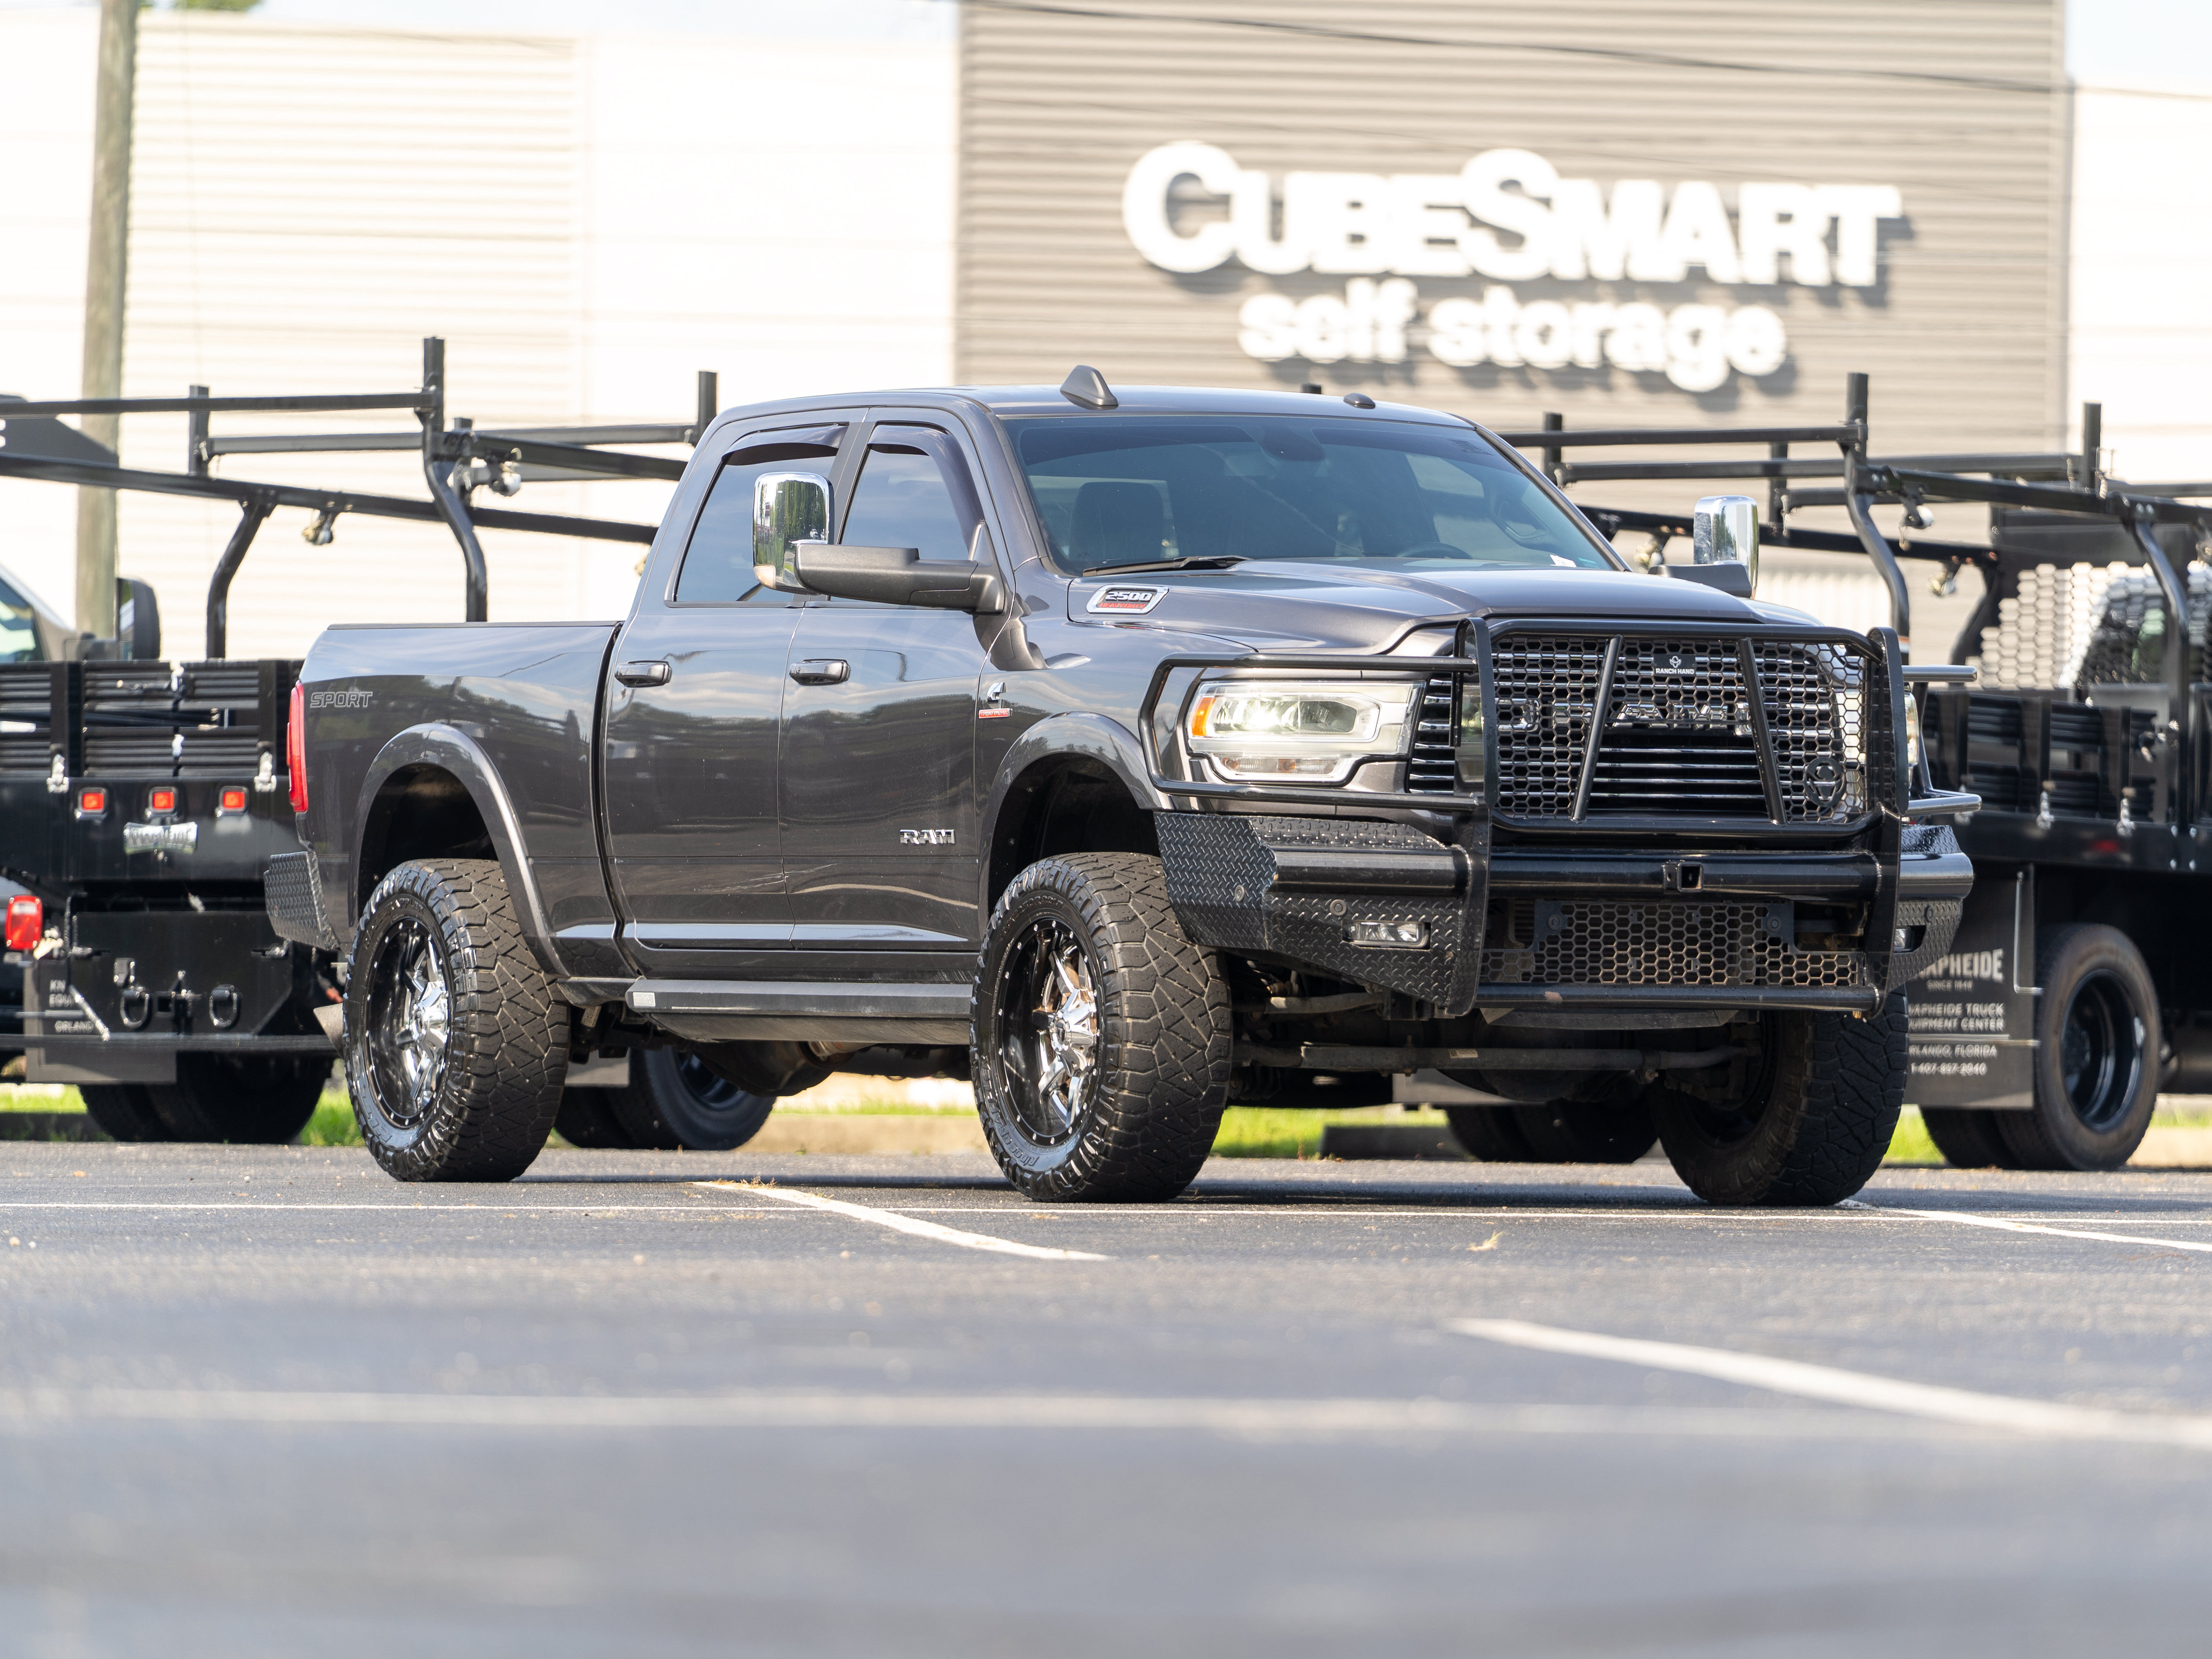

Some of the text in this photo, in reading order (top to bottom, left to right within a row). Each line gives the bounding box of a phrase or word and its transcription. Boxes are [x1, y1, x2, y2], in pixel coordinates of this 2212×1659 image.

[1238, 277, 1787, 391] self storage
[1105, 591, 1152, 601] 2500
[310, 691, 373, 708] SPORT
[900, 829, 955, 844] RAM
[1913, 949, 2003, 983] APHEIDE
[1926, 979, 1952, 991] SINCE
[1908, 1002, 2004, 1017] NAPHEIDE TRUCK
[1961, 1017, 2004, 1031] CENTER
[1908, 1044, 1998, 1058] RLANDO, FLORIDA
